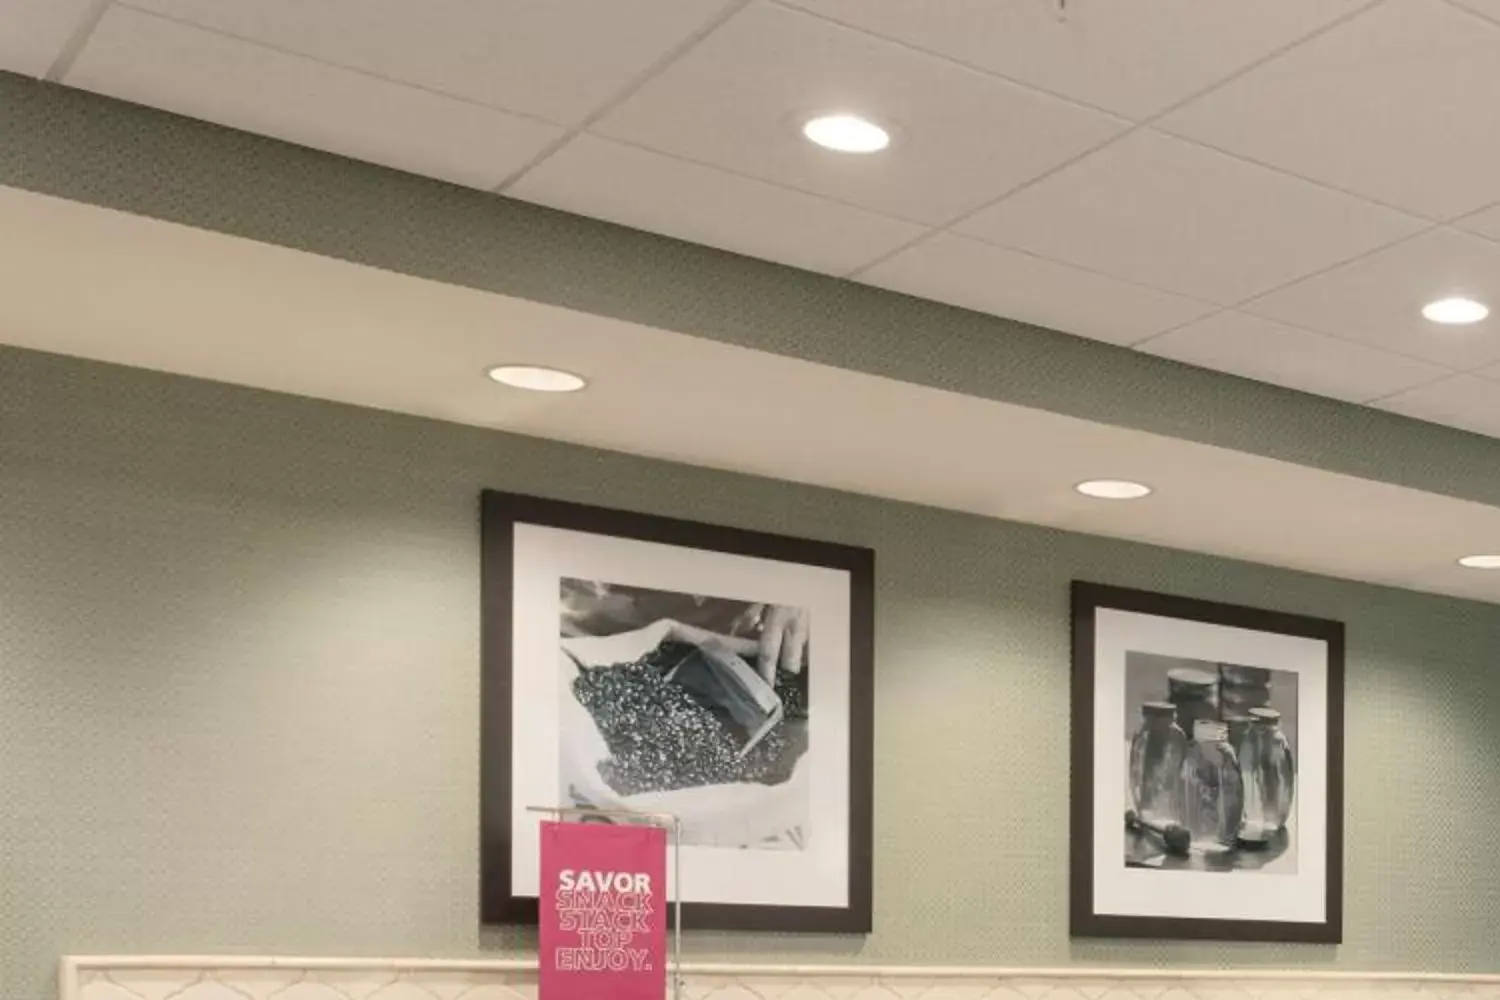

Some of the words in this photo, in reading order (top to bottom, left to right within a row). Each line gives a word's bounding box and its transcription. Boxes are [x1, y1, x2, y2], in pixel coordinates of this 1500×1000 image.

[559, 869, 651, 893] SAVOR
[559, 909, 650, 932] STACK
[577, 928, 633, 950] TOP
[555, 948, 653, 971] ENJOY.
